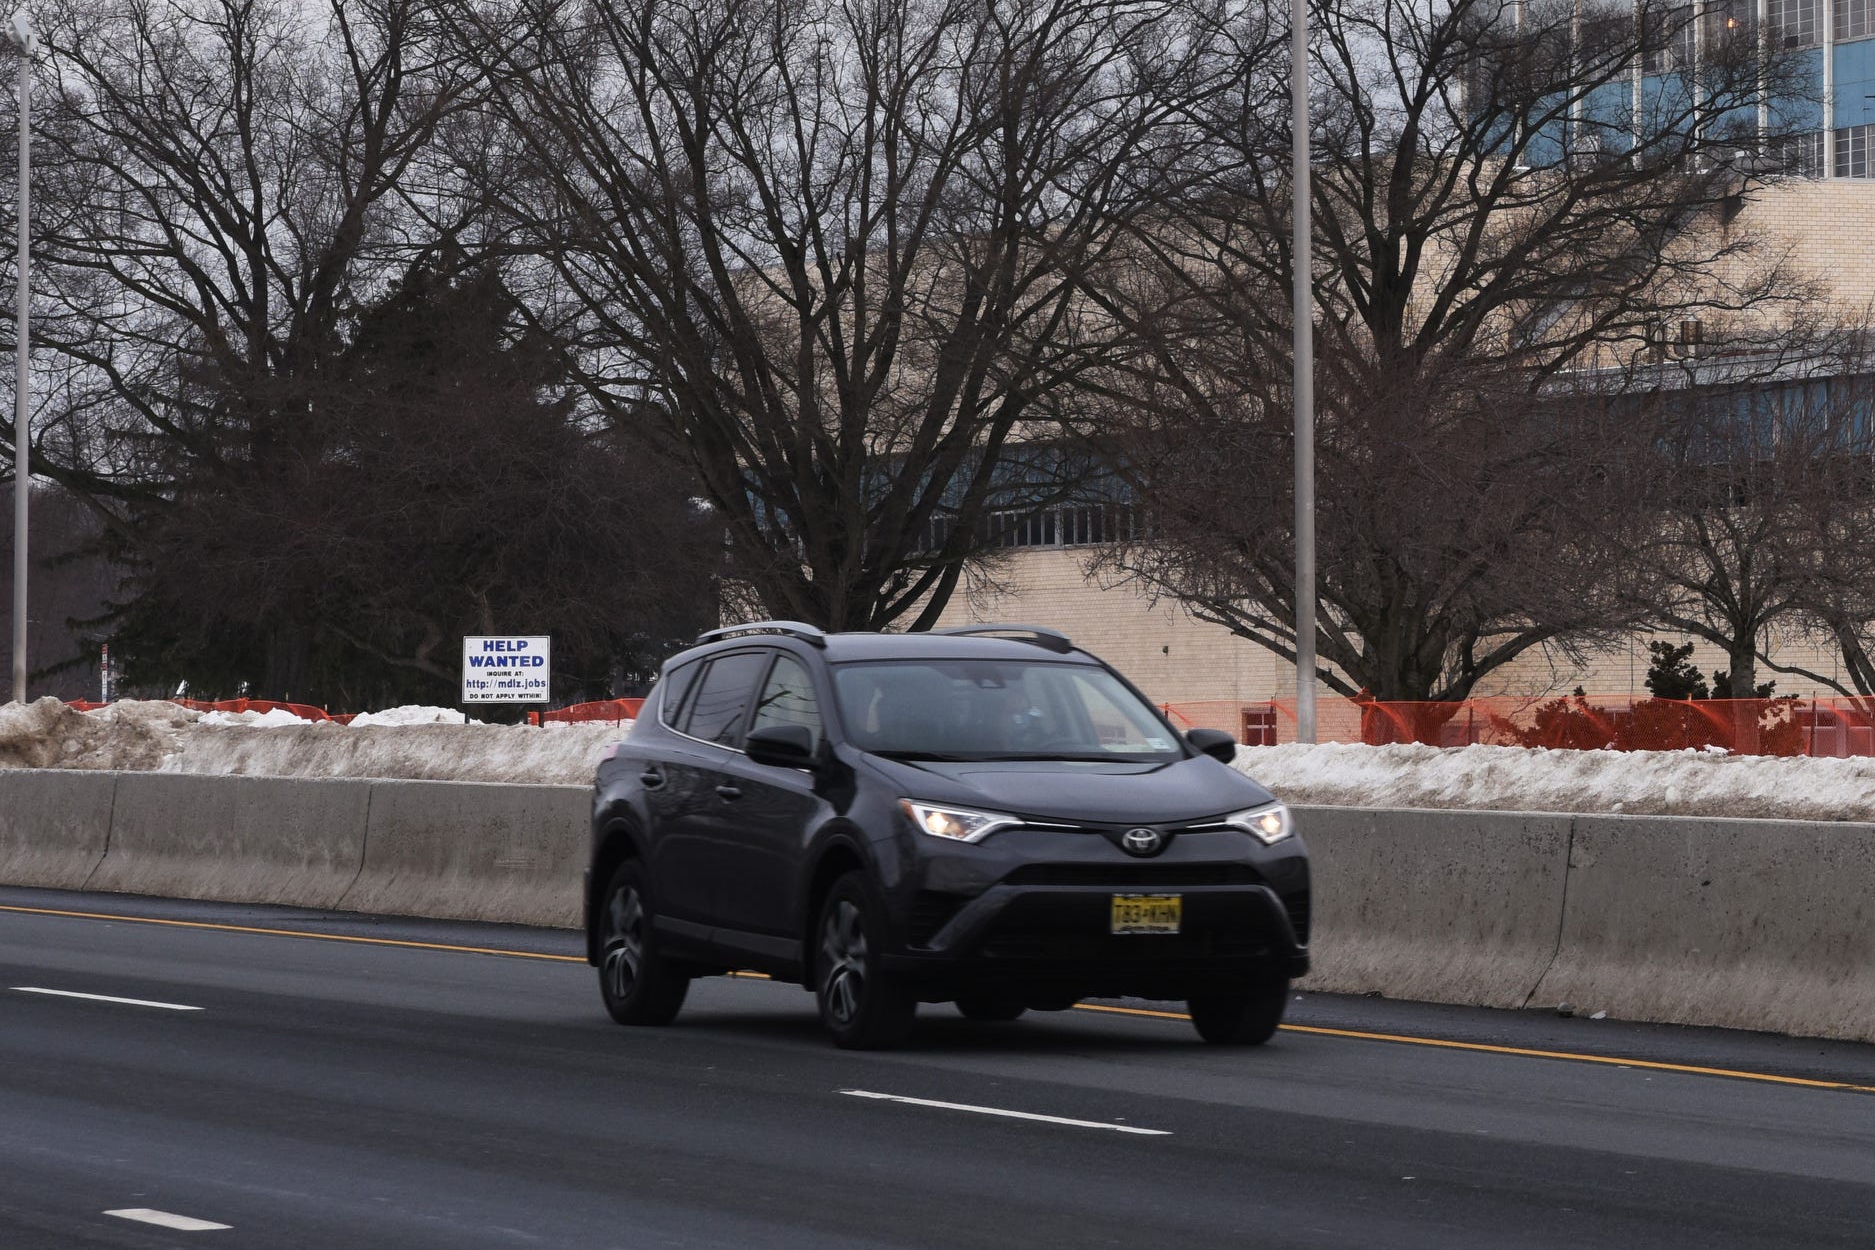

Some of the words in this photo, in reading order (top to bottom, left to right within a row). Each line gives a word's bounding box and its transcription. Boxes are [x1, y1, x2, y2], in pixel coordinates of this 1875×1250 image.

[483, 640, 529, 652] HELP
[469, 655, 544, 668] WANTED
[466, 678, 546, 690] http://mdlz.jobs
